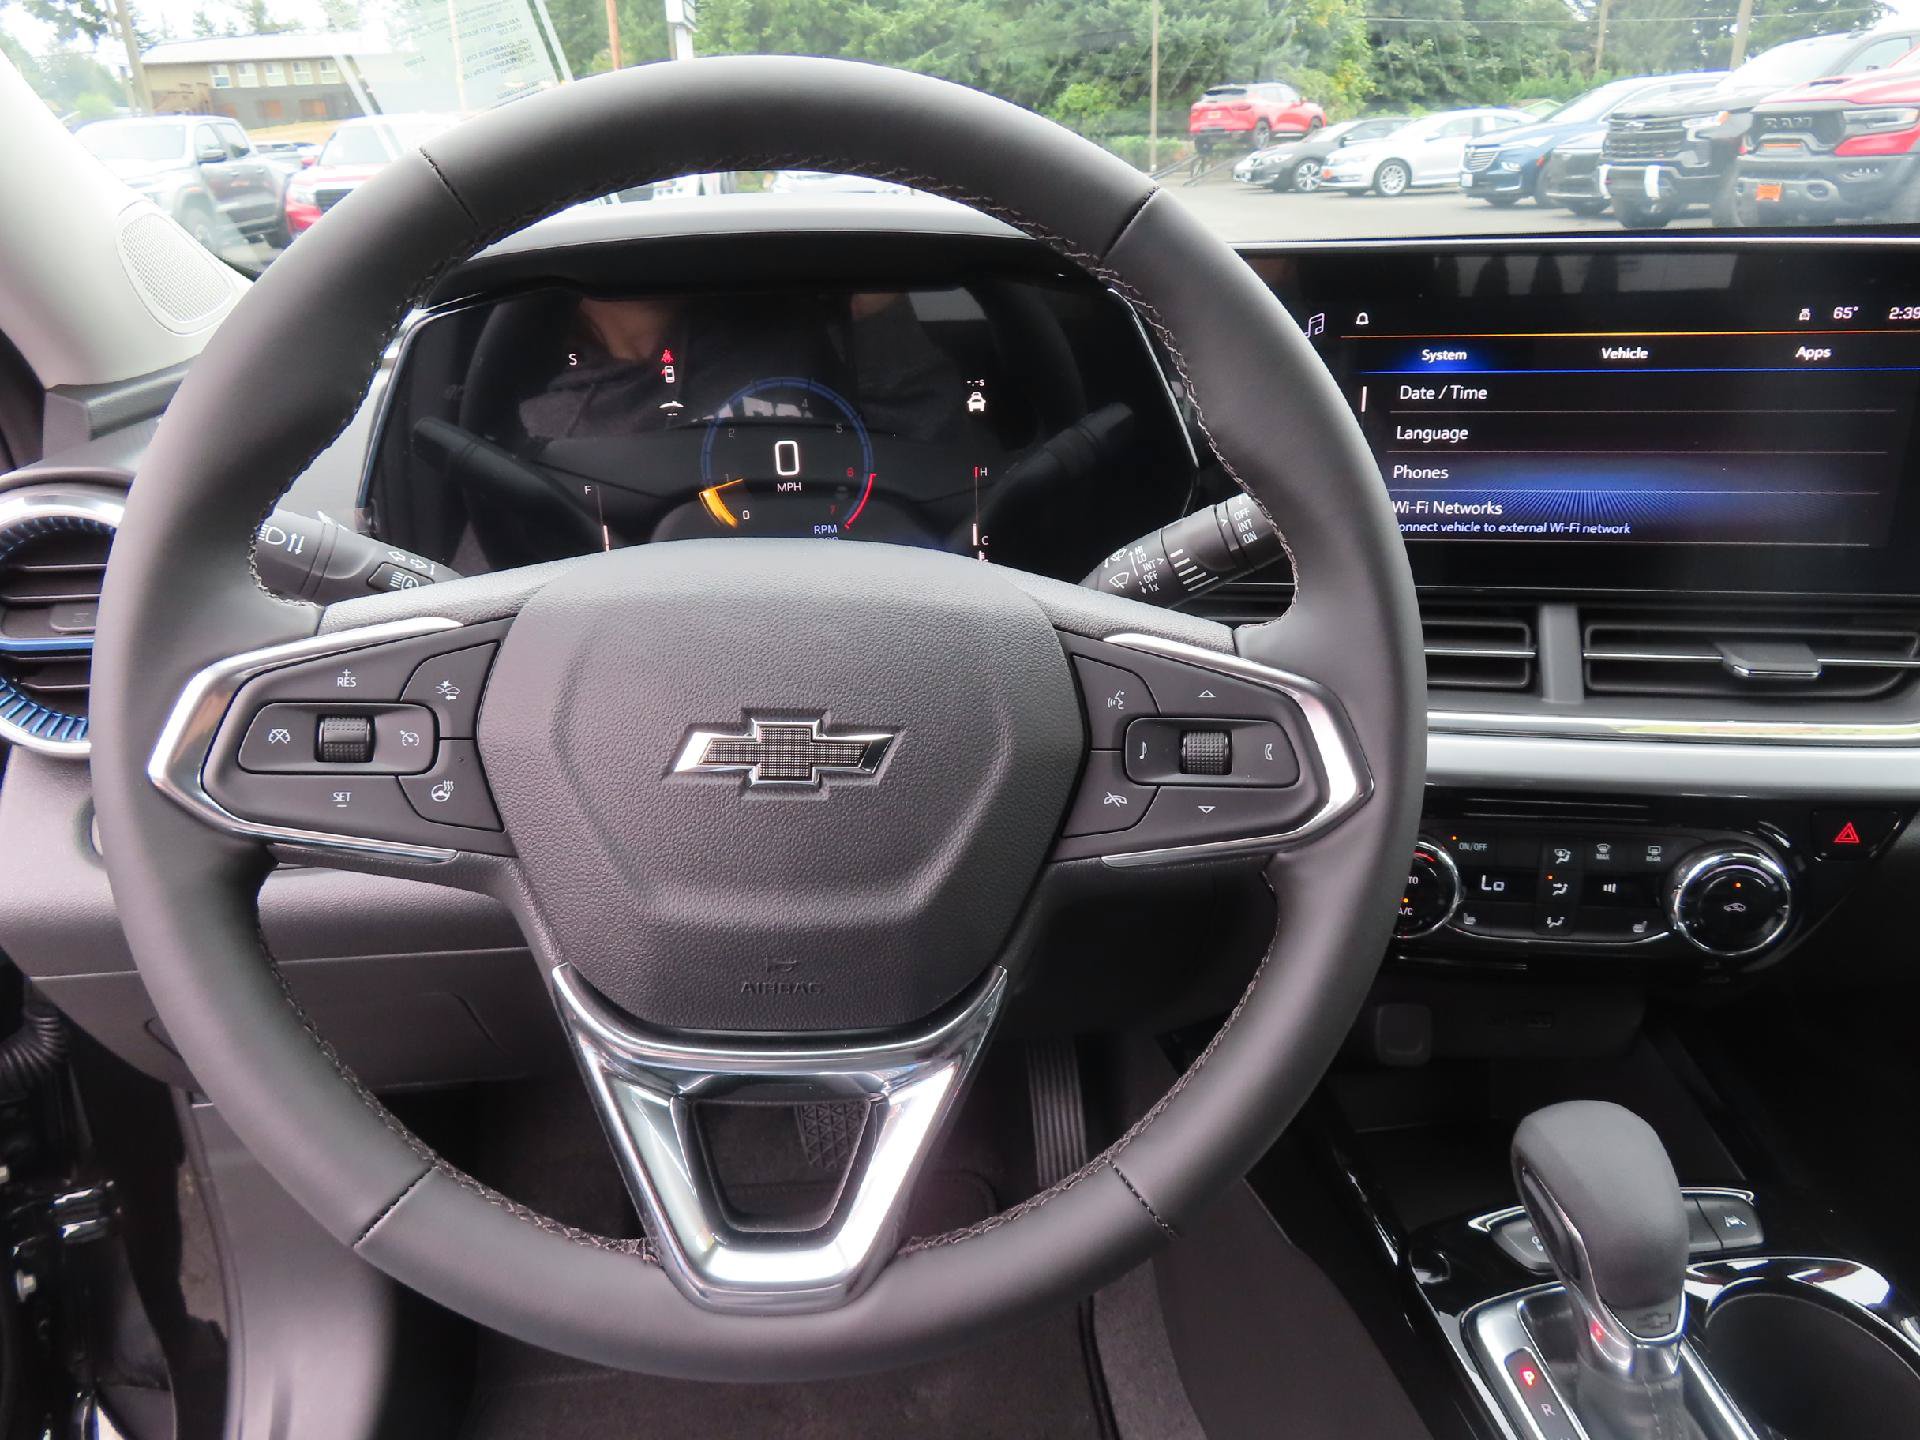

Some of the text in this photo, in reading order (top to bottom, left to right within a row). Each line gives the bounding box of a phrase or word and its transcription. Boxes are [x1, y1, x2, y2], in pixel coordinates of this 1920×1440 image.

[1833, 306, 1859, 319] 65°
[568, 353, 578, 366] S
[1421, 346, 1832, 363] System Vehicle Apps
[1400, 384, 1488, 400] Date / Time
[1396, 426, 1469, 443] Language
[774, 440, 800, 475] 0
[980, 467, 988, 476] H
[1393, 464, 1449, 479] Phones
[584, 485, 592, 495] F
[777, 482, 802, 492] MPH
[1392, 500, 1503, 515] Wi-Fi Networks
[742, 510, 750, 520] 0
[1234, 508, 1250, 521] OFF
[814, 524, 838, 535] RPM
[1237, 518, 1253, 533] INT
[1399, 522, 1631, 534] onnect vehicle to external Wi-Fi network
[981, 535, 989, 545] C
[1242, 531, 1258, 543] ON
[1143, 570, 1158, 584] OFF
[337, 677, 356, 688] RES
[333, 792, 351, 802] SET
[740, 981, 821, 995] AIRBAG
[1522, 1369, 1536, 1385] P
[1541, 1403, 1555, 1417] R
